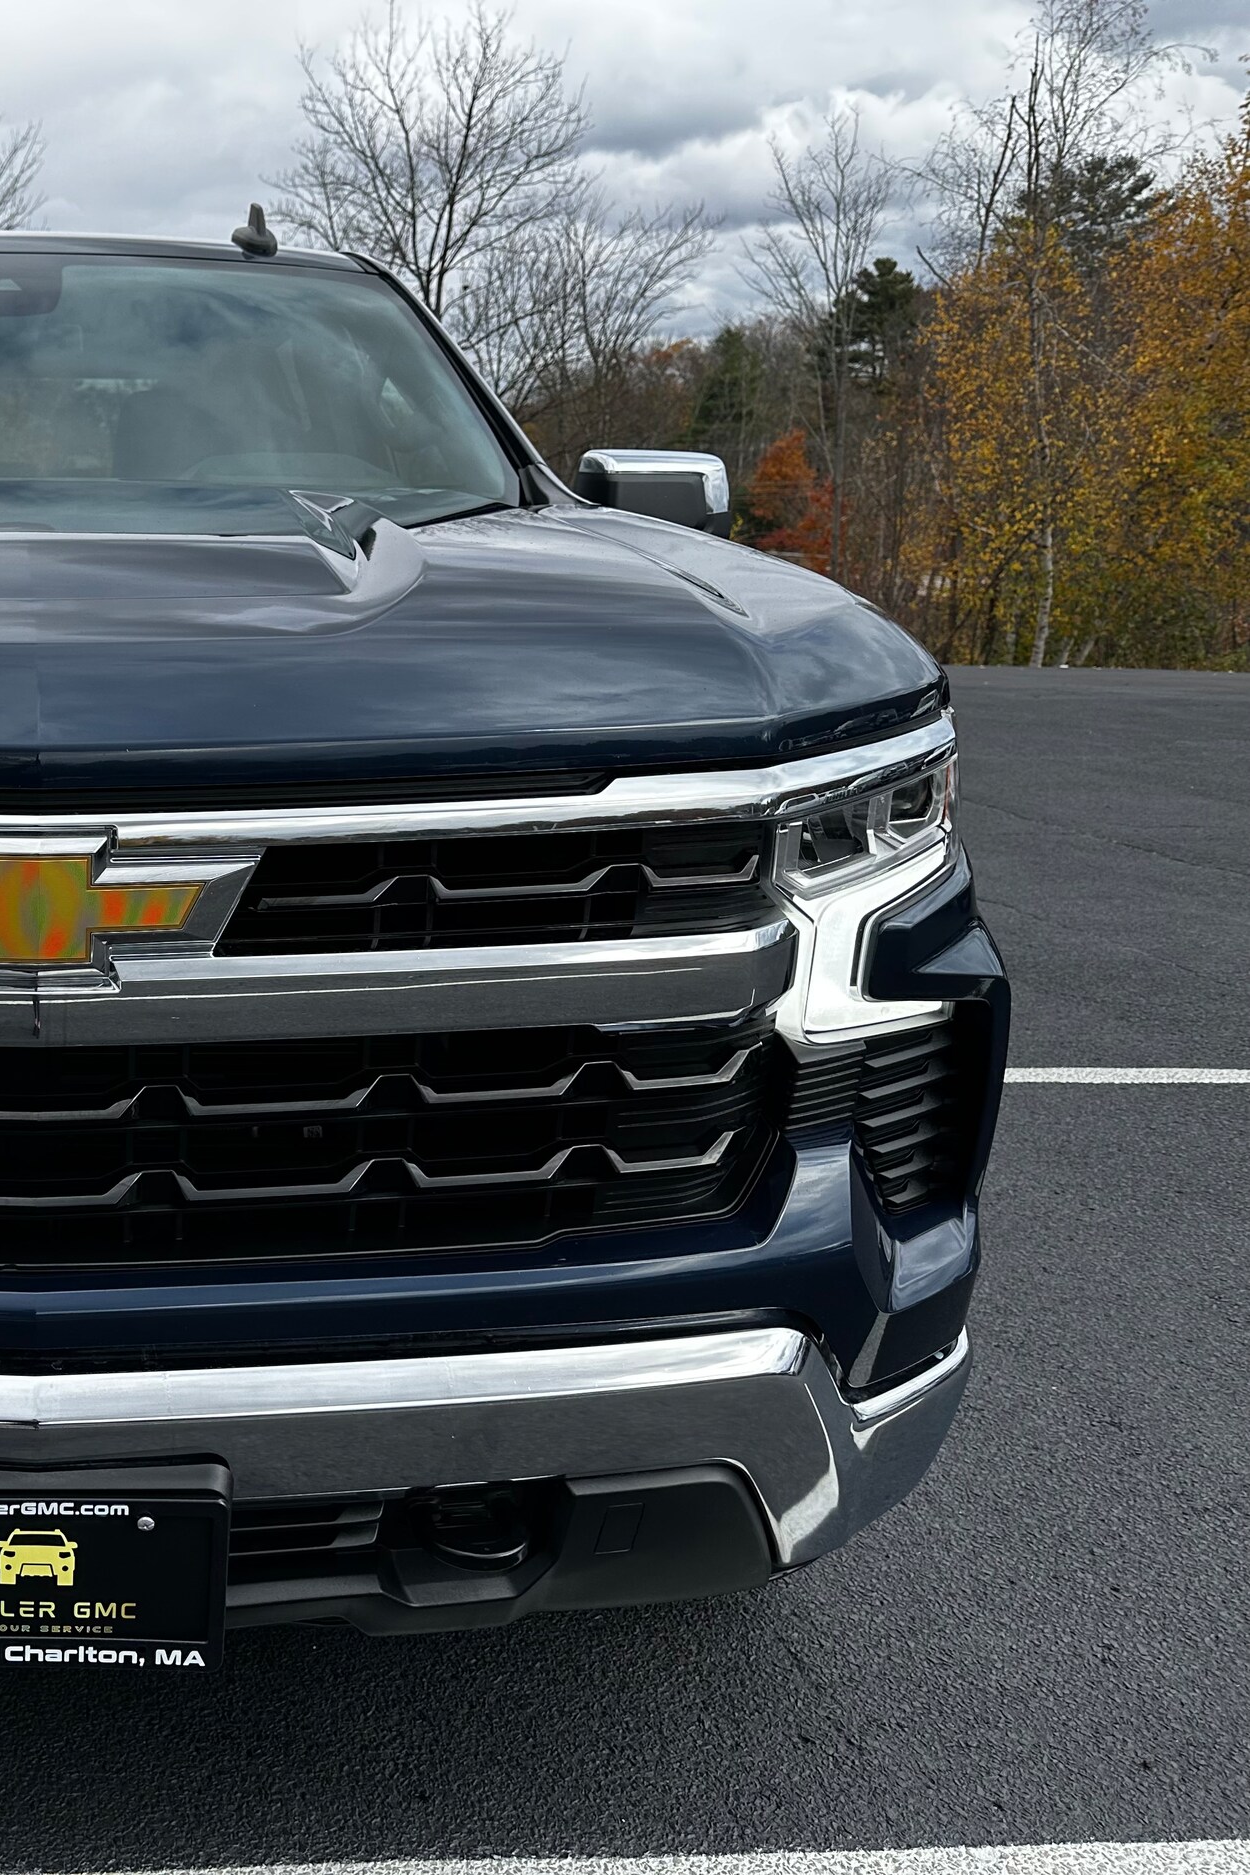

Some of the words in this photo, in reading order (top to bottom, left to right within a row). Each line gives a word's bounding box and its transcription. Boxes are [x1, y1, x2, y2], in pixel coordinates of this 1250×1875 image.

[73, 1601, 137, 1619] GMC
[39, 1624, 113, 1634] SERVICE
[4, 1644, 145, 1667] Charlton,
[154, 1648, 206, 1667] MA
